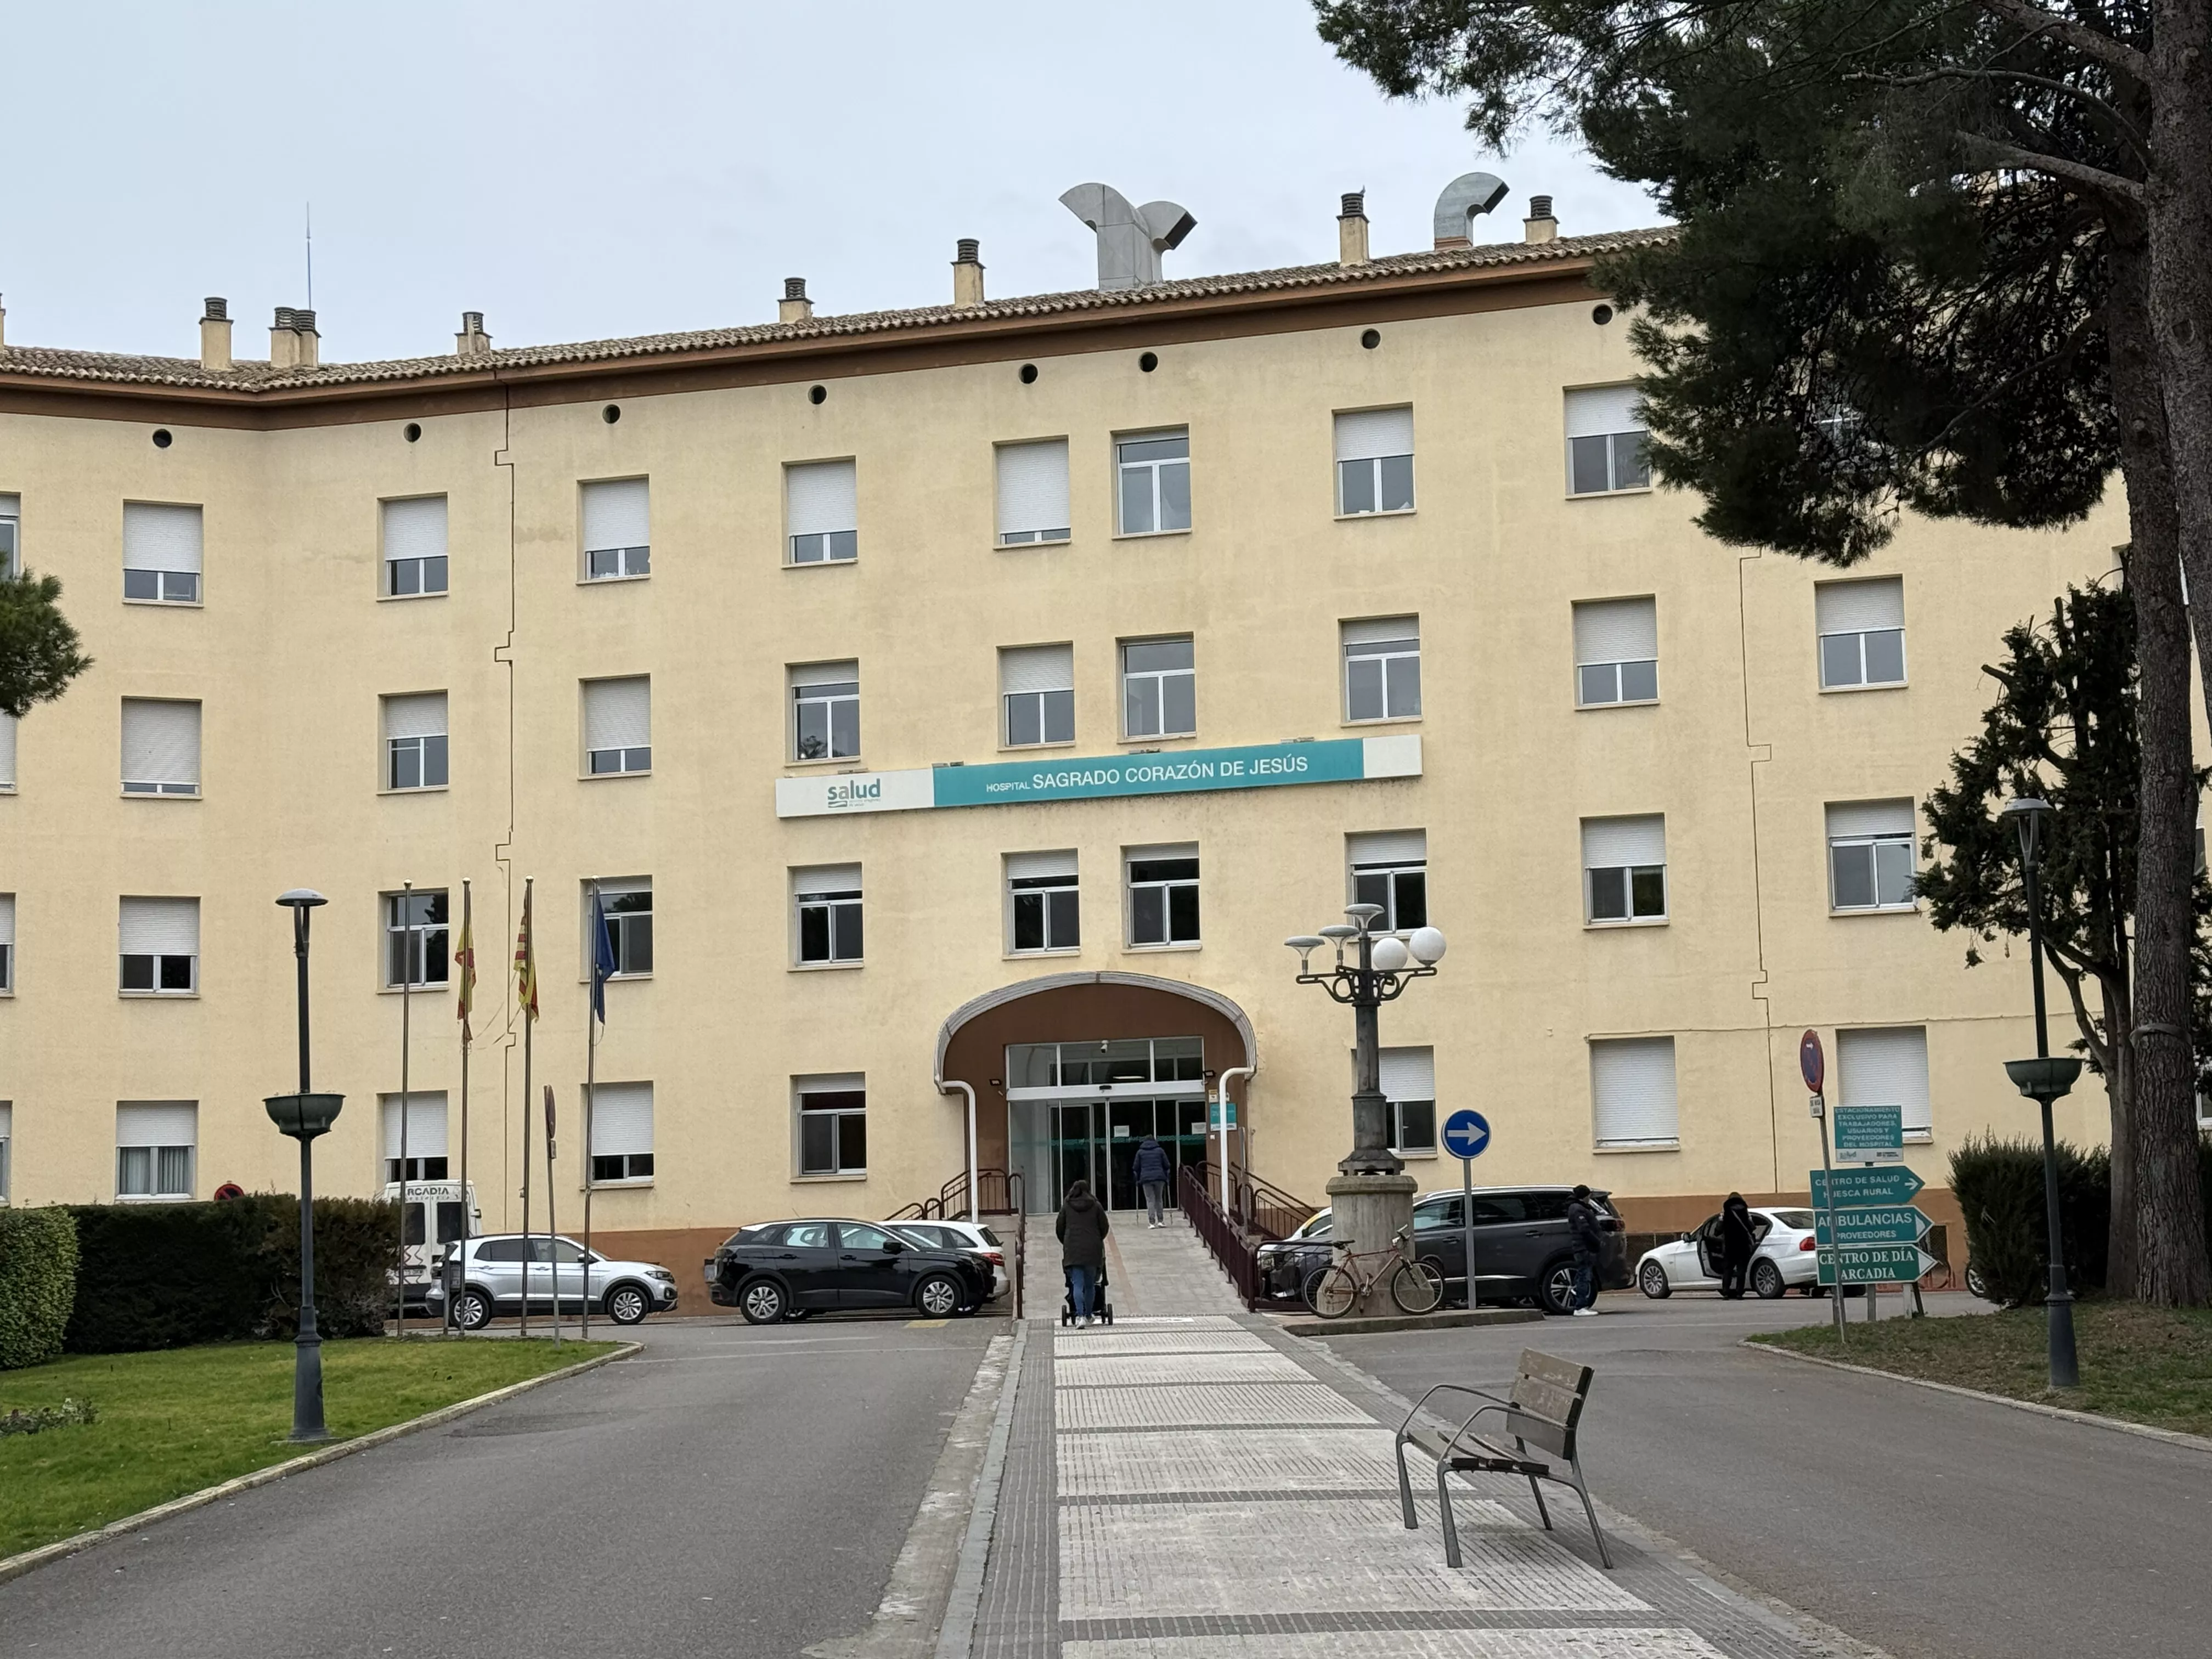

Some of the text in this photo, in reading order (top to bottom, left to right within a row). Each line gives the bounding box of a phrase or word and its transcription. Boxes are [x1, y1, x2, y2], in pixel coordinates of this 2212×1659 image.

[986, 754, 1308, 792] HOSPITAL SAGRADO CORAZÓN DE JESÚS
[827, 778, 881, 800] salud
[1870, 1175, 1900, 1183] SALUD
[408, 1187, 449, 1196] RCADIA
[1863, 1188, 1894, 1197] RURAL
[1837, 1230, 1897, 1240] PROVEEDORES
[1819, 1247, 1914, 1265] CENTRO DE DÍA
[1841, 1267, 1896, 1280] ARCADIA
